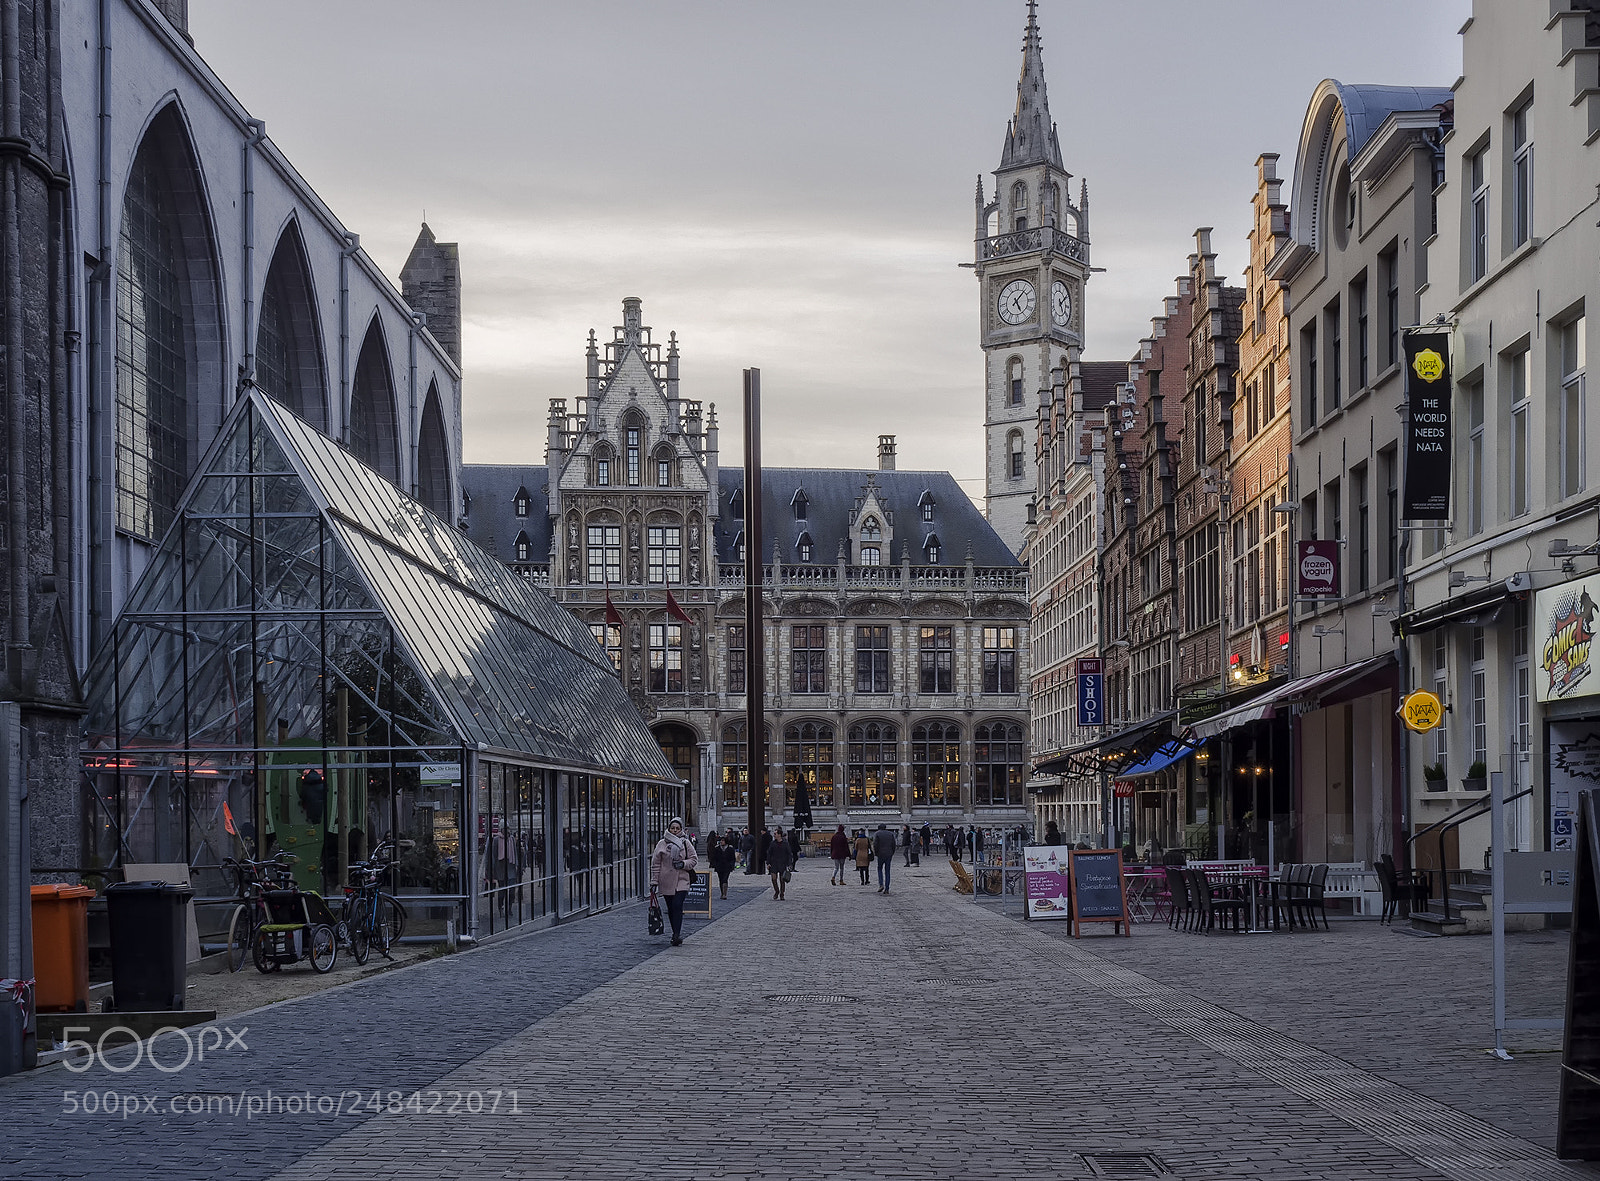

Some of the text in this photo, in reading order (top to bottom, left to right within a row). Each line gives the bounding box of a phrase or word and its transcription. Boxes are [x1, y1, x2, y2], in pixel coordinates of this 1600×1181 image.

[1418, 359, 1439, 372] NATA
[1422, 398, 1439, 409] THE
[1413, 413, 1448, 423] WORLD
[1415, 428, 1445, 438] NEEDS
[1416, 442, 1444, 452] NATA
[1304, 560, 1331, 568] frozen
[1304, 567, 1331, 576] yogurt
[1303, 586, 1333, 594] moochie
[1544, 621, 1578, 671] COMIC
[1568, 640, 1591, 672] SANS
[1082, 662, 1096, 670] NIGHT
[1084, 675, 1097, 722] SHOP
[1408, 702, 1438, 720] NATA
[1116, 781, 1133, 796] illy
